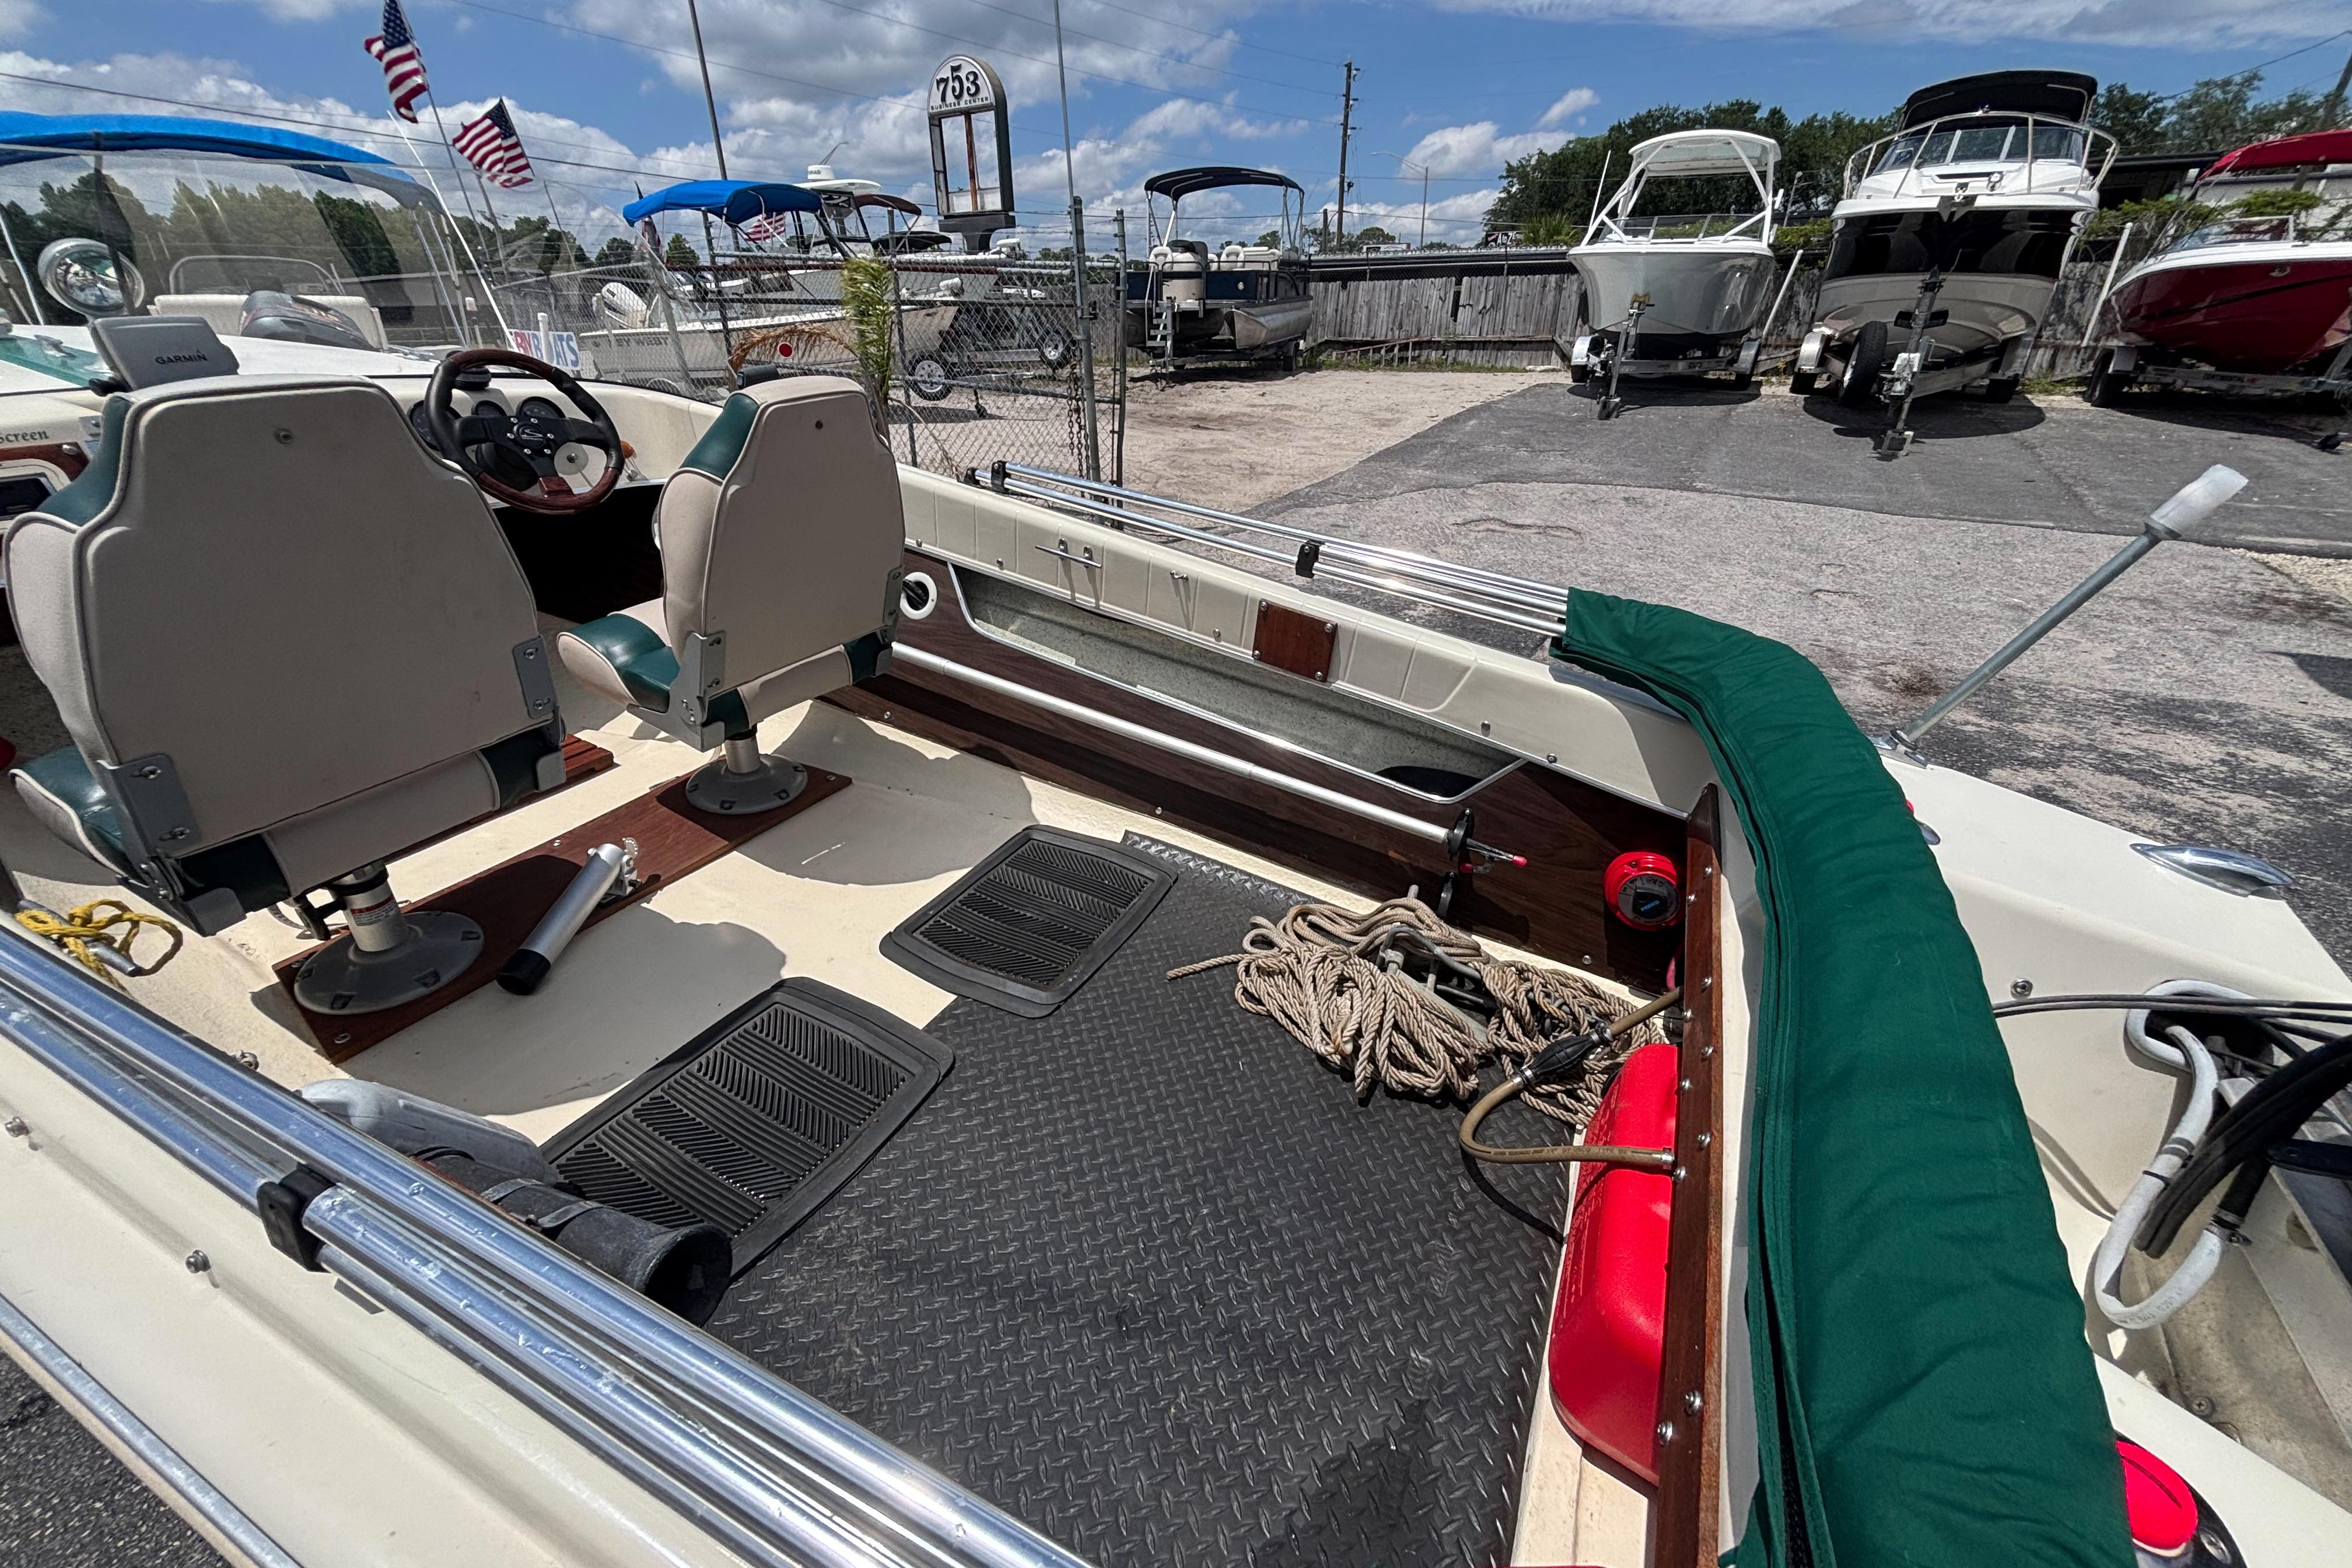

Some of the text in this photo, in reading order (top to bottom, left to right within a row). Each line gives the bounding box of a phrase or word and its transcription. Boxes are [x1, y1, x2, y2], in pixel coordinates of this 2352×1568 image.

[936, 64, 981, 104] 753
[930, 96, 989, 111] BUSINESS CENTER
[155, 352, 208, 365] GARMIN
